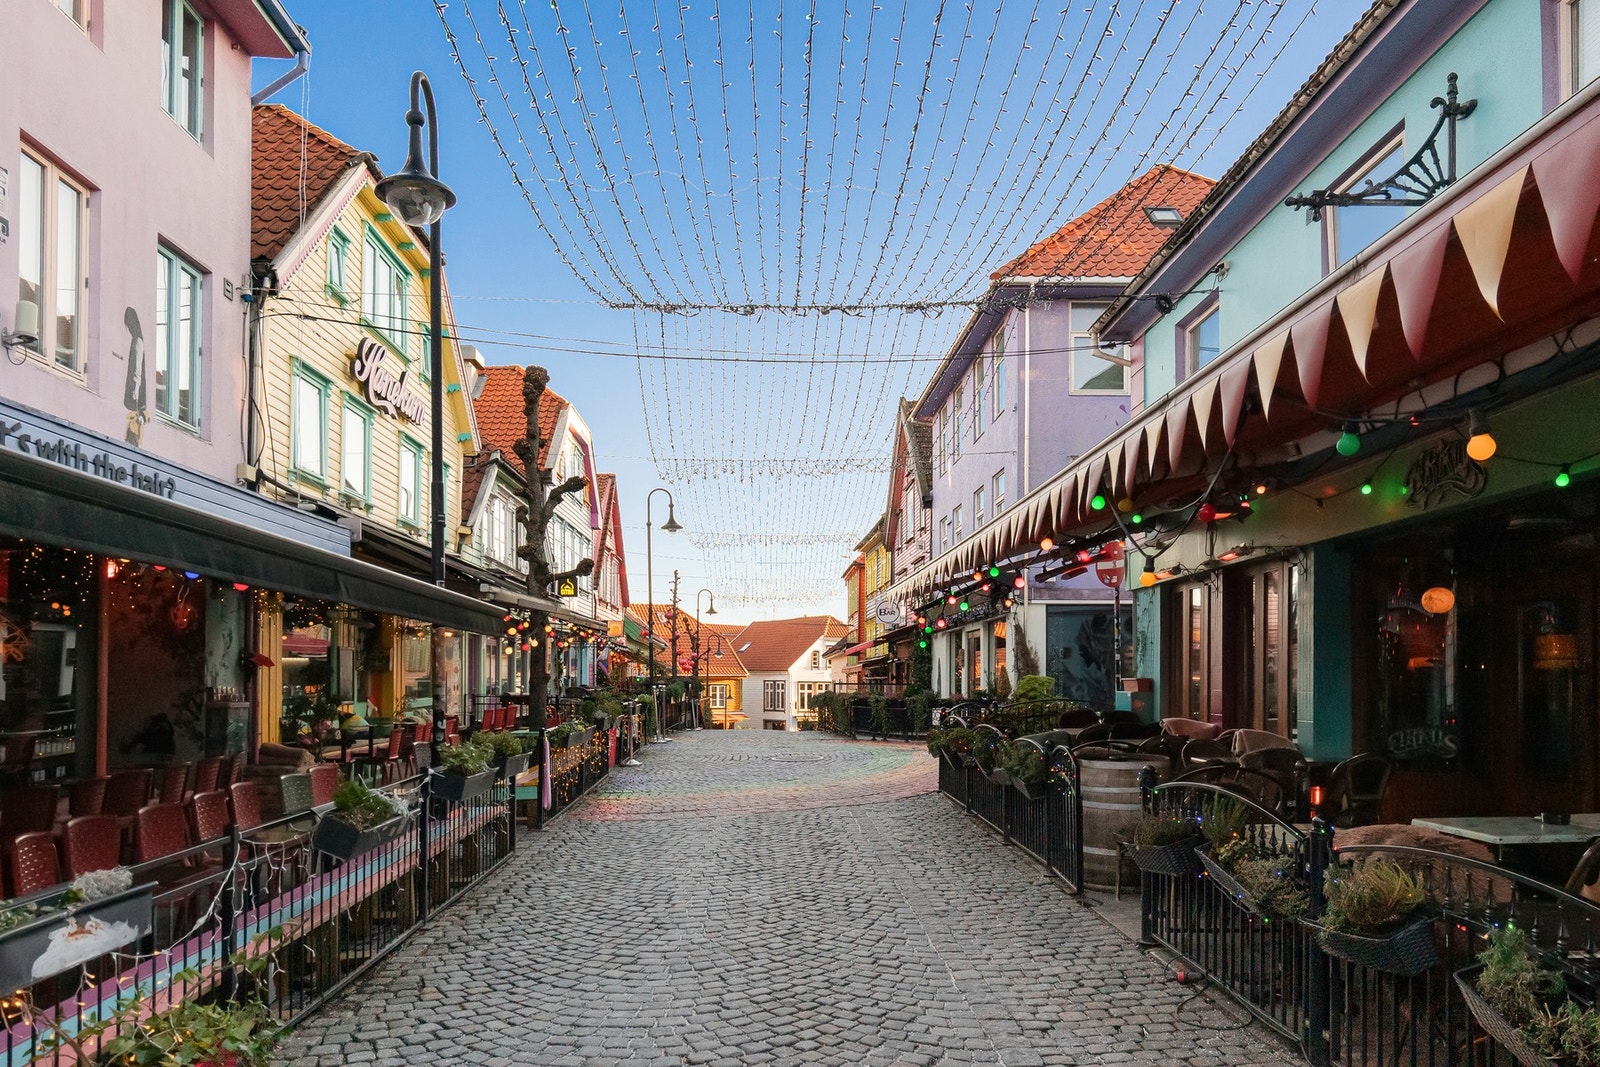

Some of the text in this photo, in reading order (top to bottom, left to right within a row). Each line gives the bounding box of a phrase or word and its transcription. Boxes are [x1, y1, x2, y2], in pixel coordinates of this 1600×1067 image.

[351, 338, 425, 426] Hanekam
[36, 438, 88, 471] with
[93, 453, 127, 483] the
[132, 463, 177, 499] hair?
[1388, 728, 1457, 758] CIRKUS
